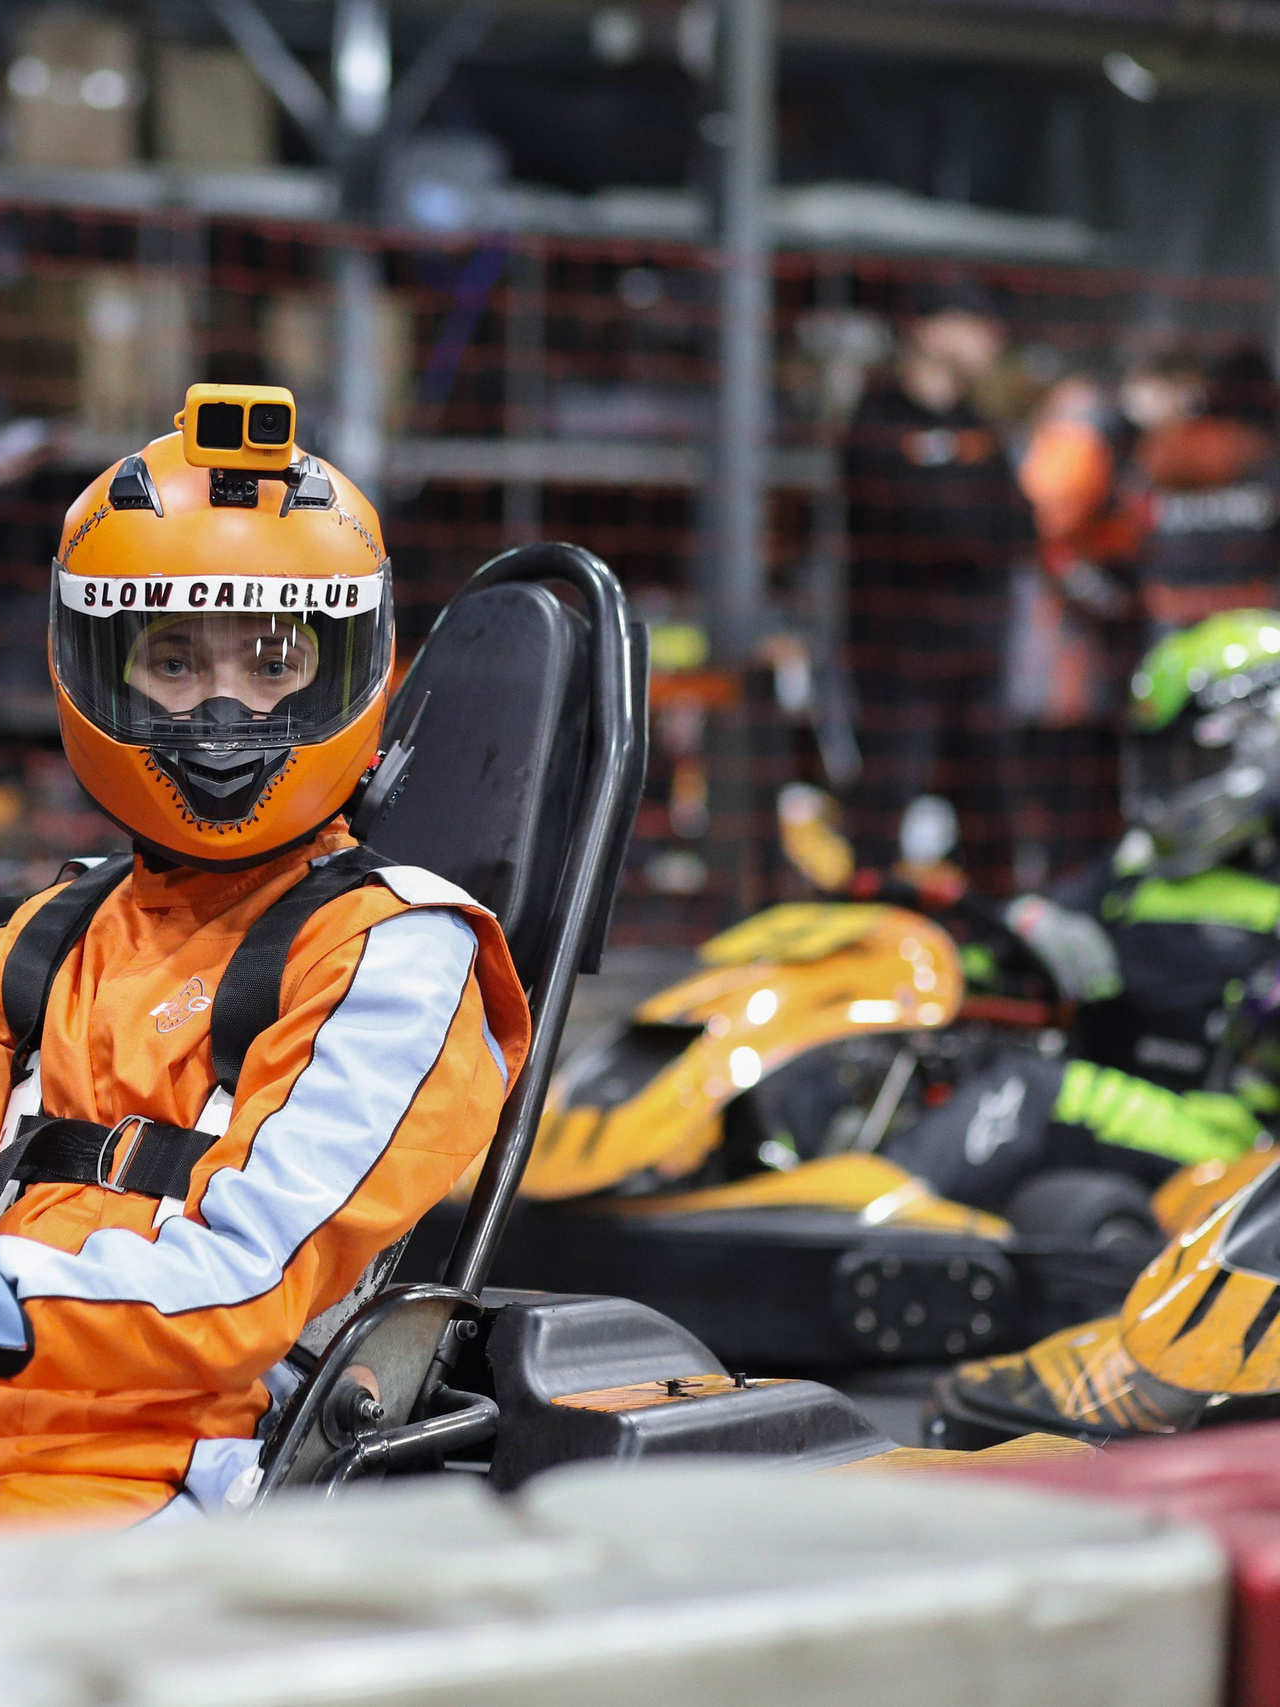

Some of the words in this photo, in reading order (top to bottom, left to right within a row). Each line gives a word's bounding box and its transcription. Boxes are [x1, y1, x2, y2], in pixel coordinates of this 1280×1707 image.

[83, 582, 174, 608] SLOW
[188, 582, 264, 608] CAR
[279, 583, 360, 608] CLUB
